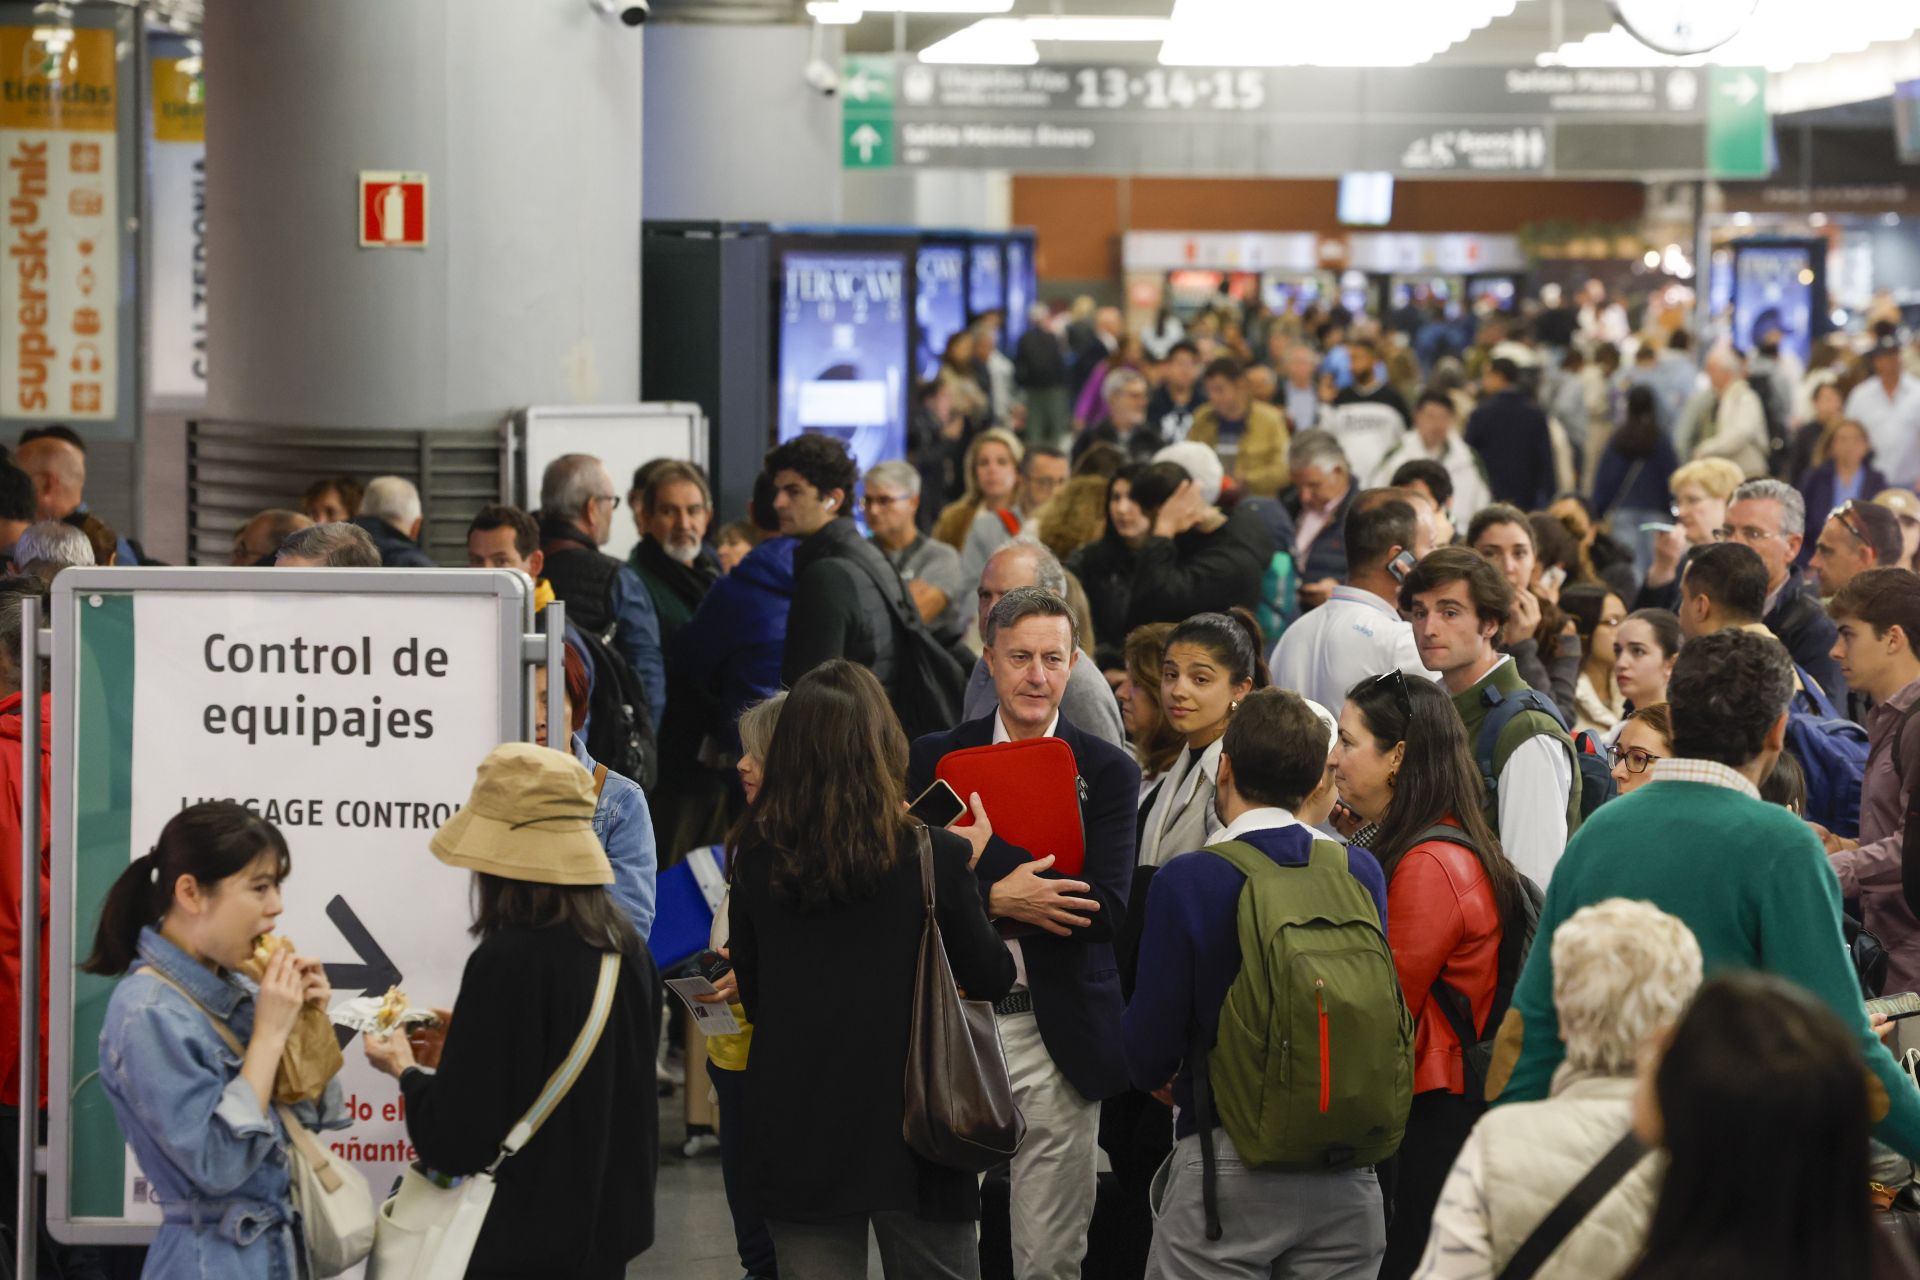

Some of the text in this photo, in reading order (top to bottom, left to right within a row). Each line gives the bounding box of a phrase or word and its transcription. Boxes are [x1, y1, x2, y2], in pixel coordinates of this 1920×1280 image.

[204, 633, 449, 678] Control de
[203, 694, 435, 748] equipajes
[336, 800, 461, 829] CONTRO
